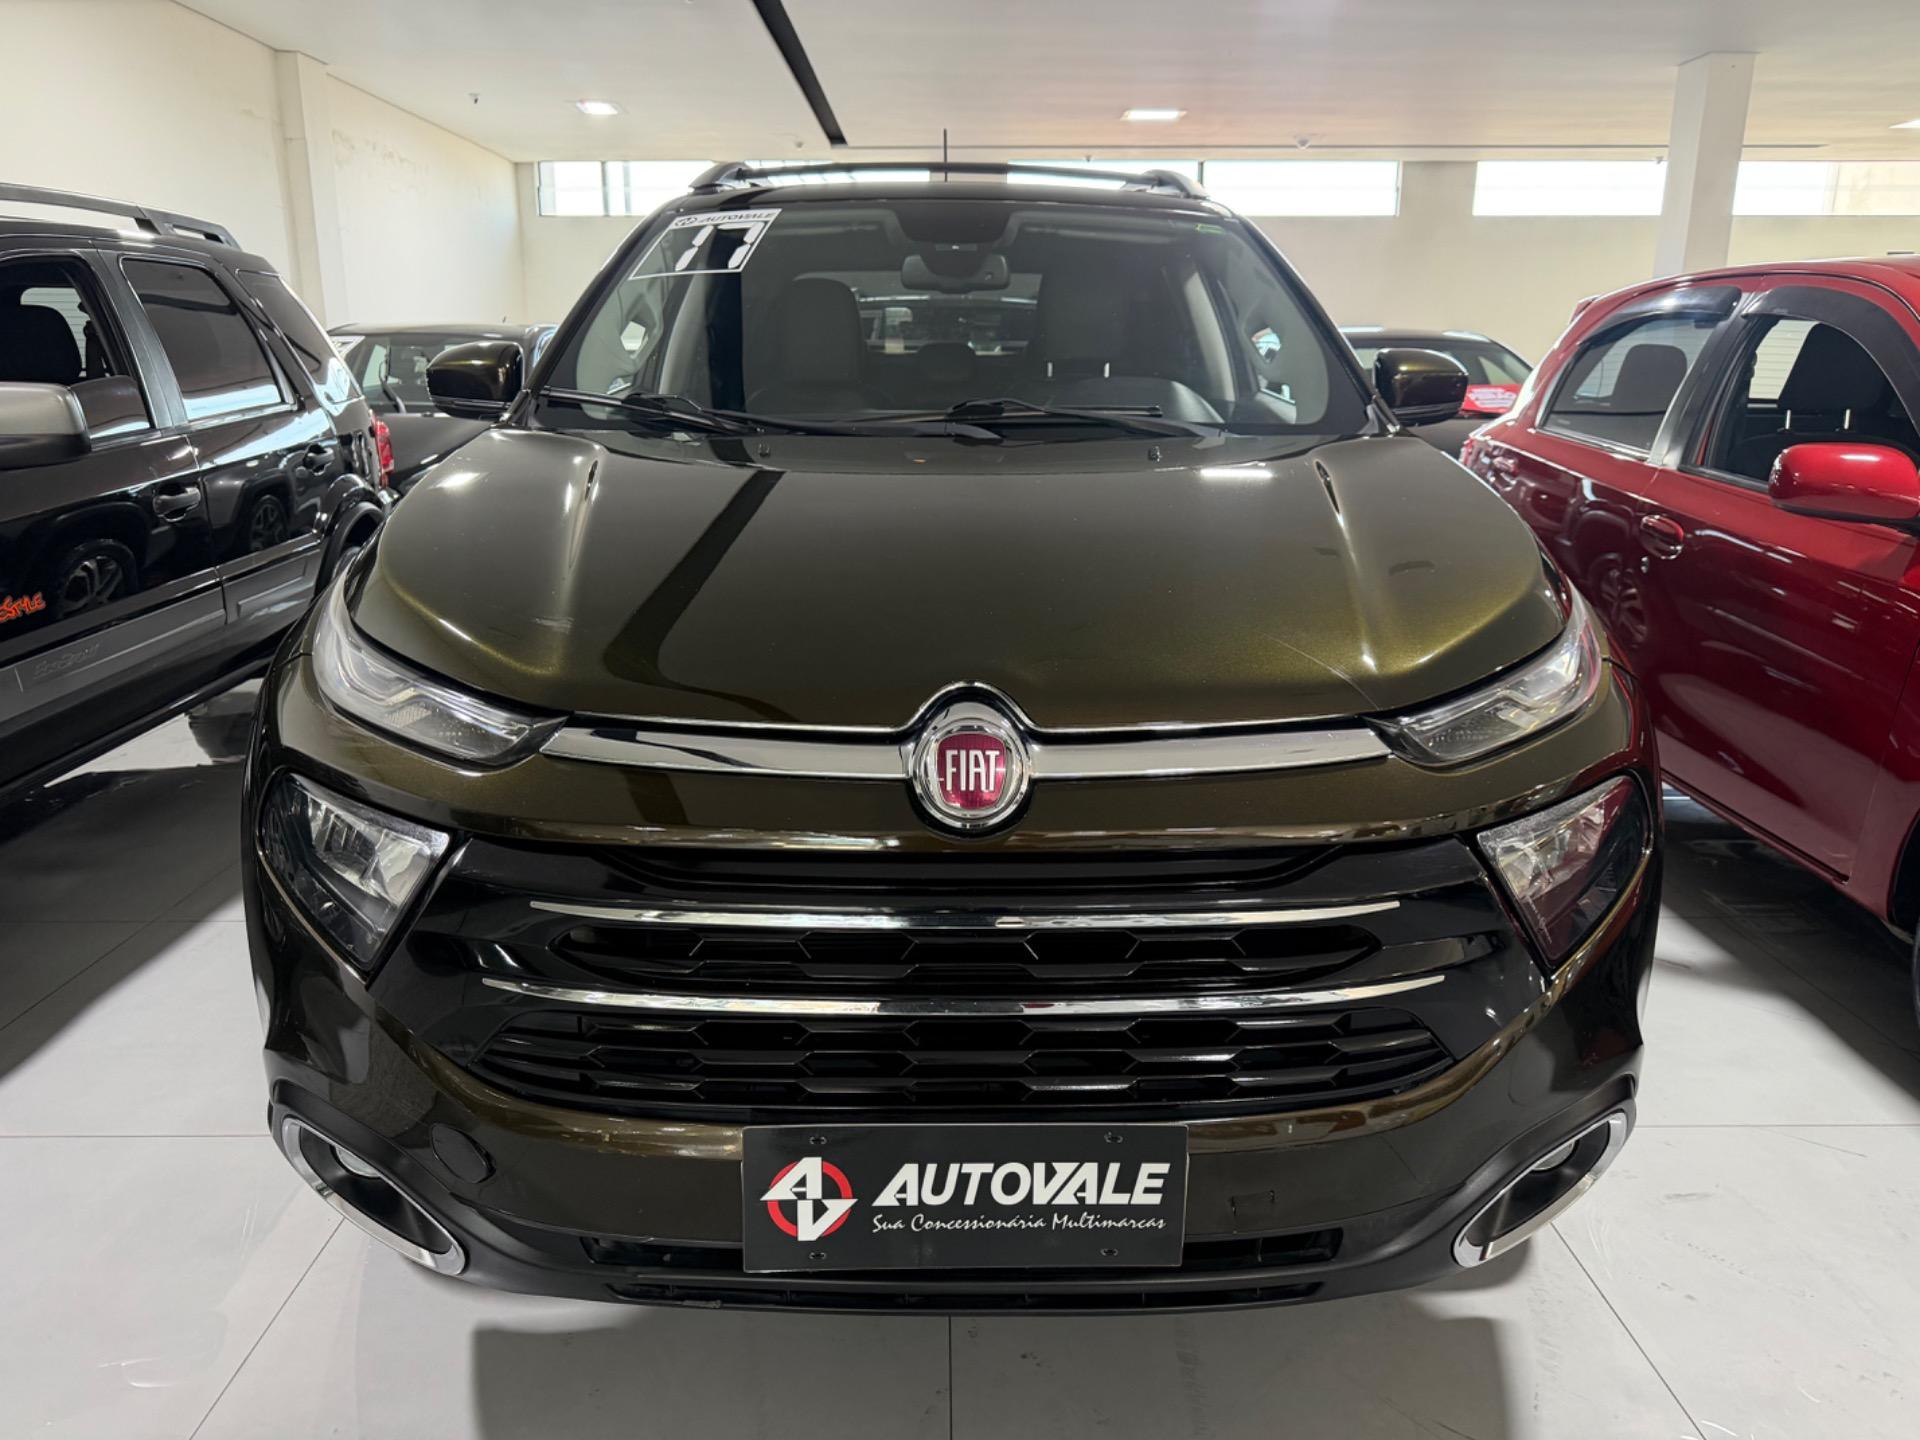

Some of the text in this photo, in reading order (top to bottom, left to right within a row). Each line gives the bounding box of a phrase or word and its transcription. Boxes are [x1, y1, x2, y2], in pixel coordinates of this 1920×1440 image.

[945, 749, 1000, 791] FIAT
[872, 1163, 1170, 1206] AUTOVALE
[873, 1212, 1165, 1232] Sua Concessionária Multimarcas
